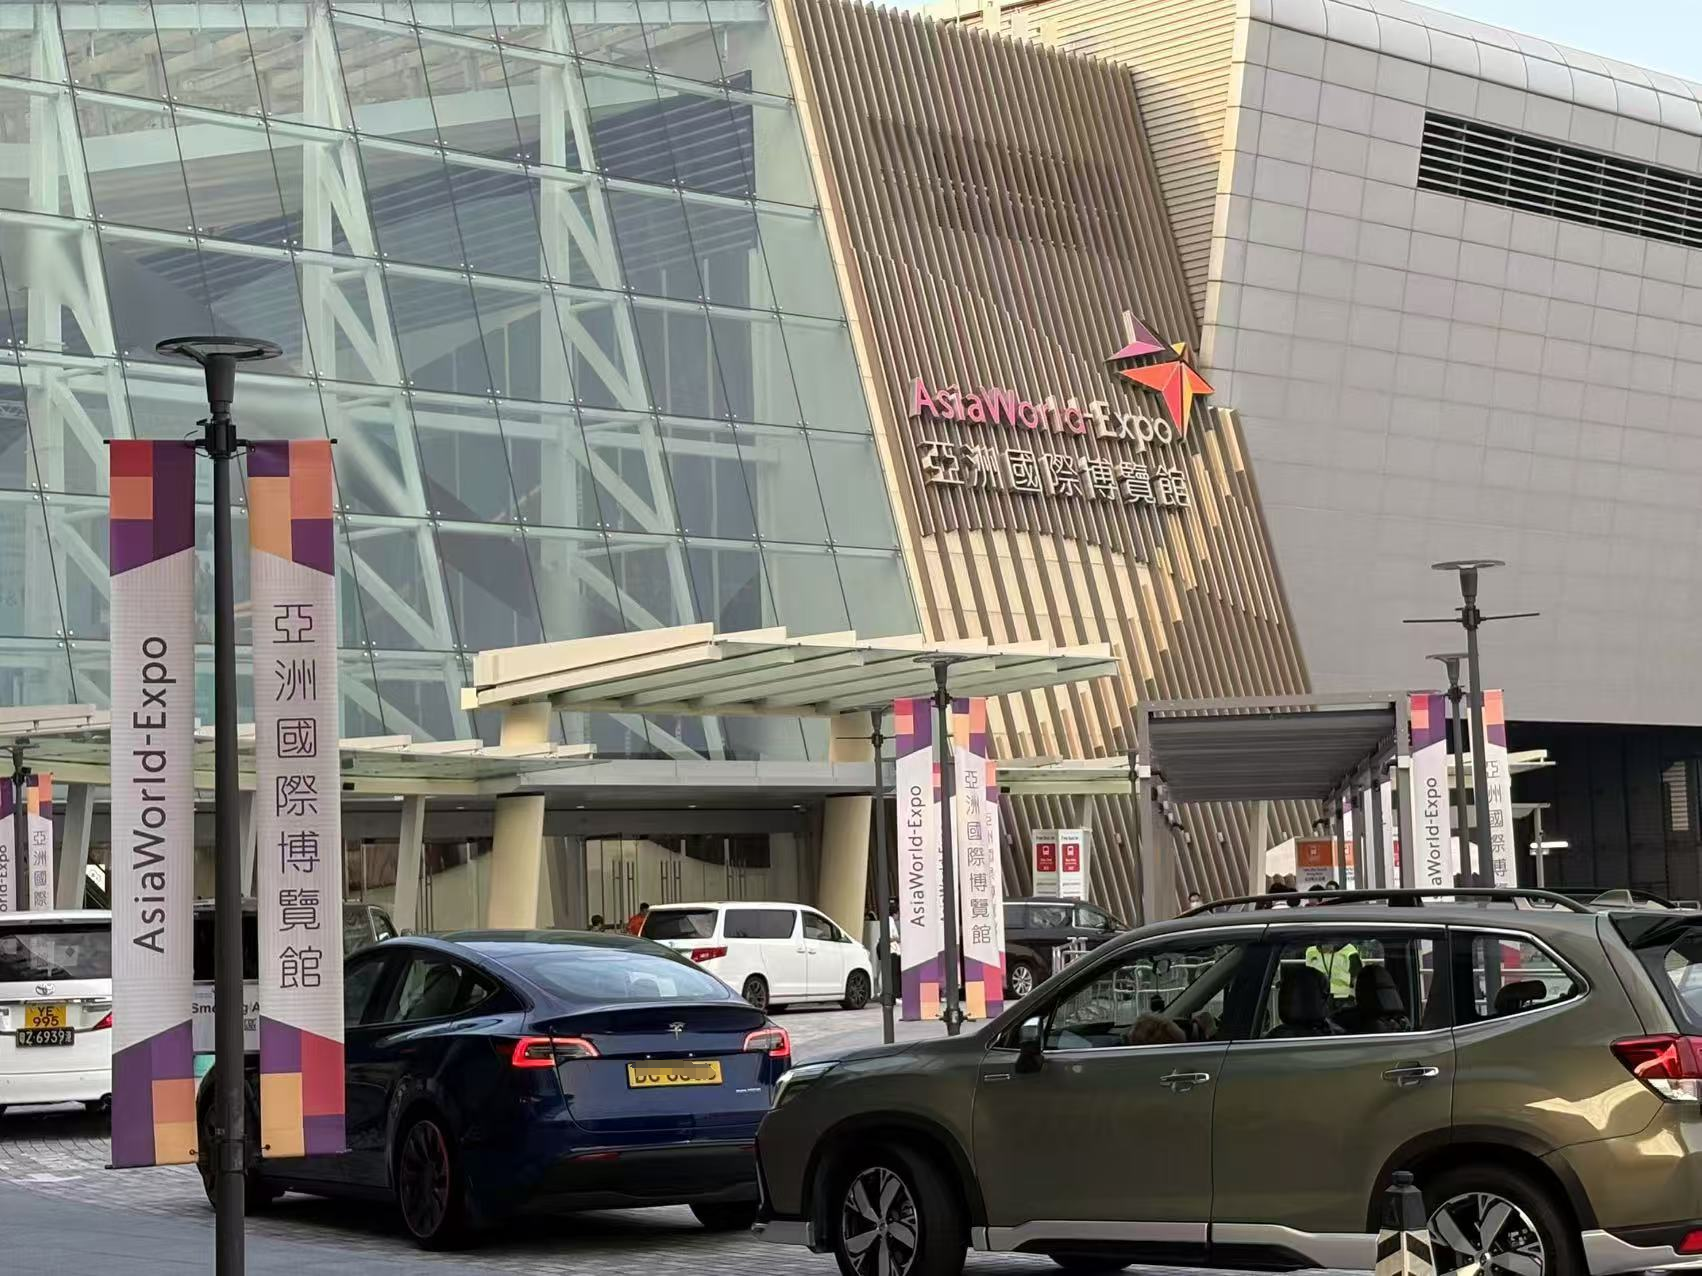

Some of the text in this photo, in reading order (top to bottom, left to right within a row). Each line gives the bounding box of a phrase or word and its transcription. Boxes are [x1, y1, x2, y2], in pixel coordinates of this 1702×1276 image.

[910, 377, 1173, 453] AsiaWorld-Expo
[917, 441, 1190, 507] 亞洲國際博覽館
[133, 636, 176, 953] AsiaWorld-Expo
[272, 603, 323, 989] 亞洲國際博覽館
[1424, 777, 1442, 886] aWorld-Expo
[32, 831, 48, 907] 亞洲國際
[907, 785, 926, 927] AsiaWorld-Expo
[964, 770, 991, 944] 亞洲國際博覽館
[32, 1016, 59, 1027] 995
[37, 1006, 54, 1017] YE
